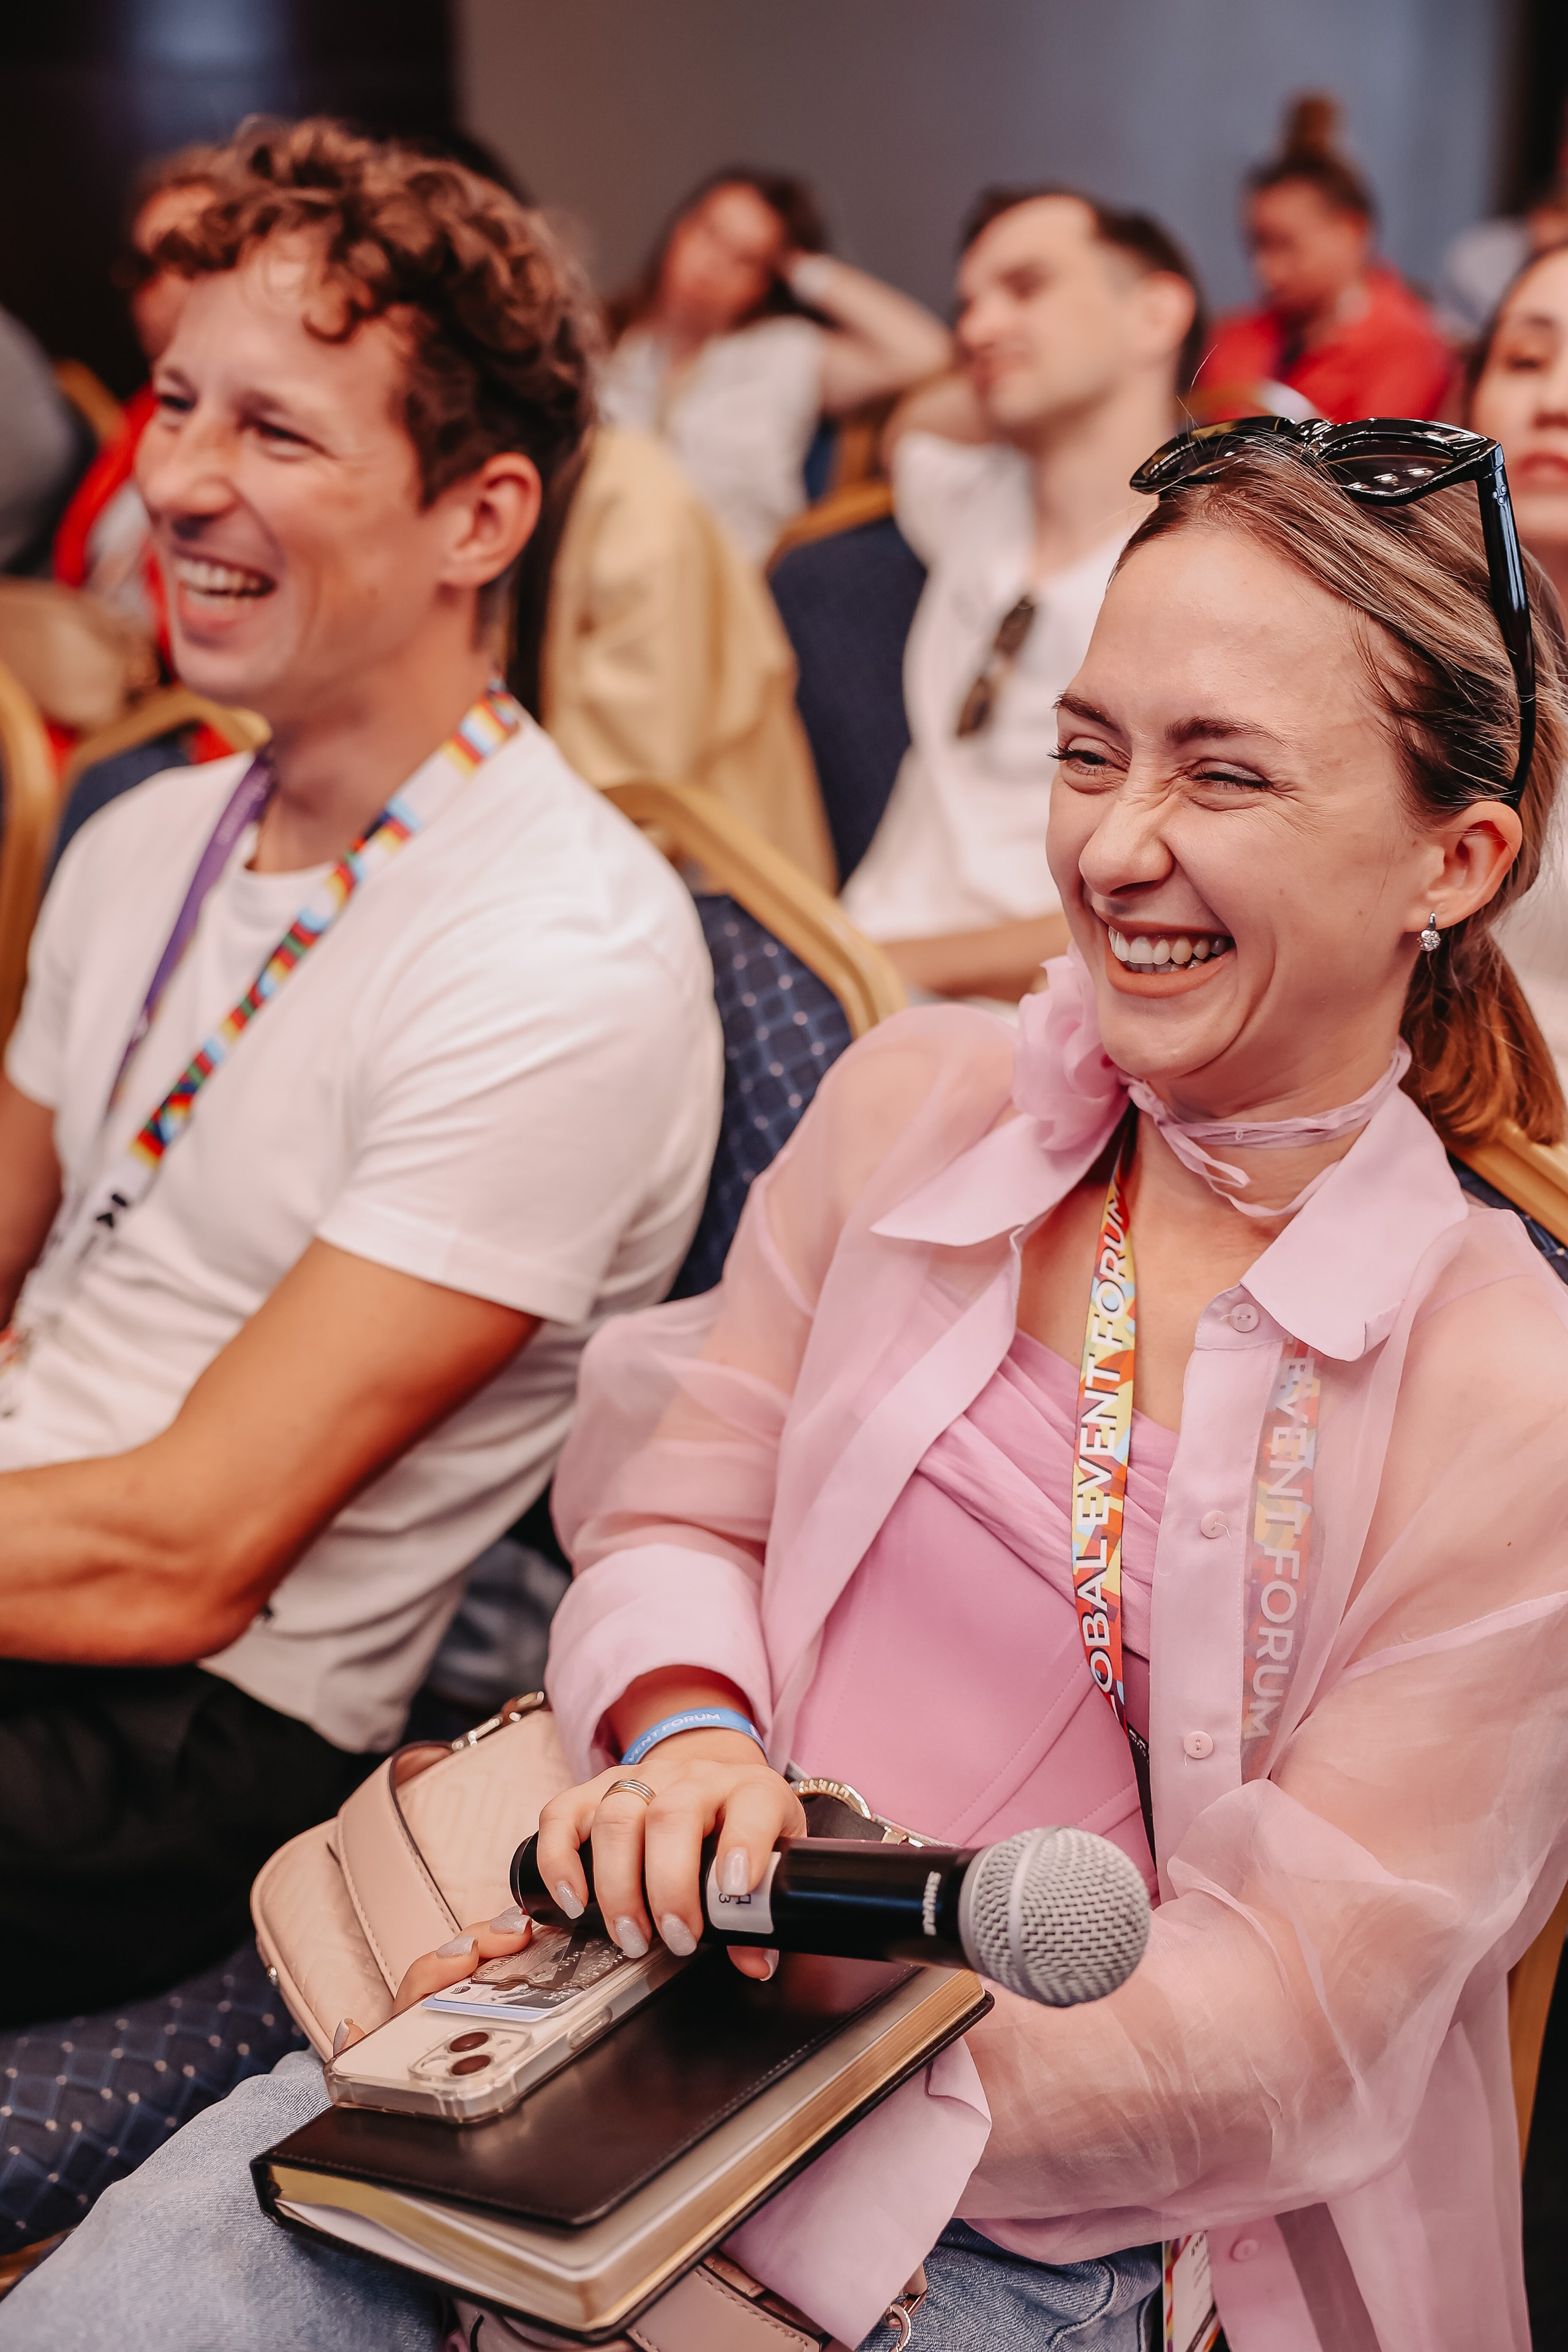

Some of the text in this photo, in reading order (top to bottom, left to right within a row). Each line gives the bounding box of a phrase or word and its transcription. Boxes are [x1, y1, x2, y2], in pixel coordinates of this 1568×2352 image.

[1090, 1185, 1126, 1349] FORUM
[1076, 1352, 1121, 1526] EVENT
[1244, 1357, 1315, 1740] EVENT FORUM
[662, 1713, 721, 1733] FORUM
